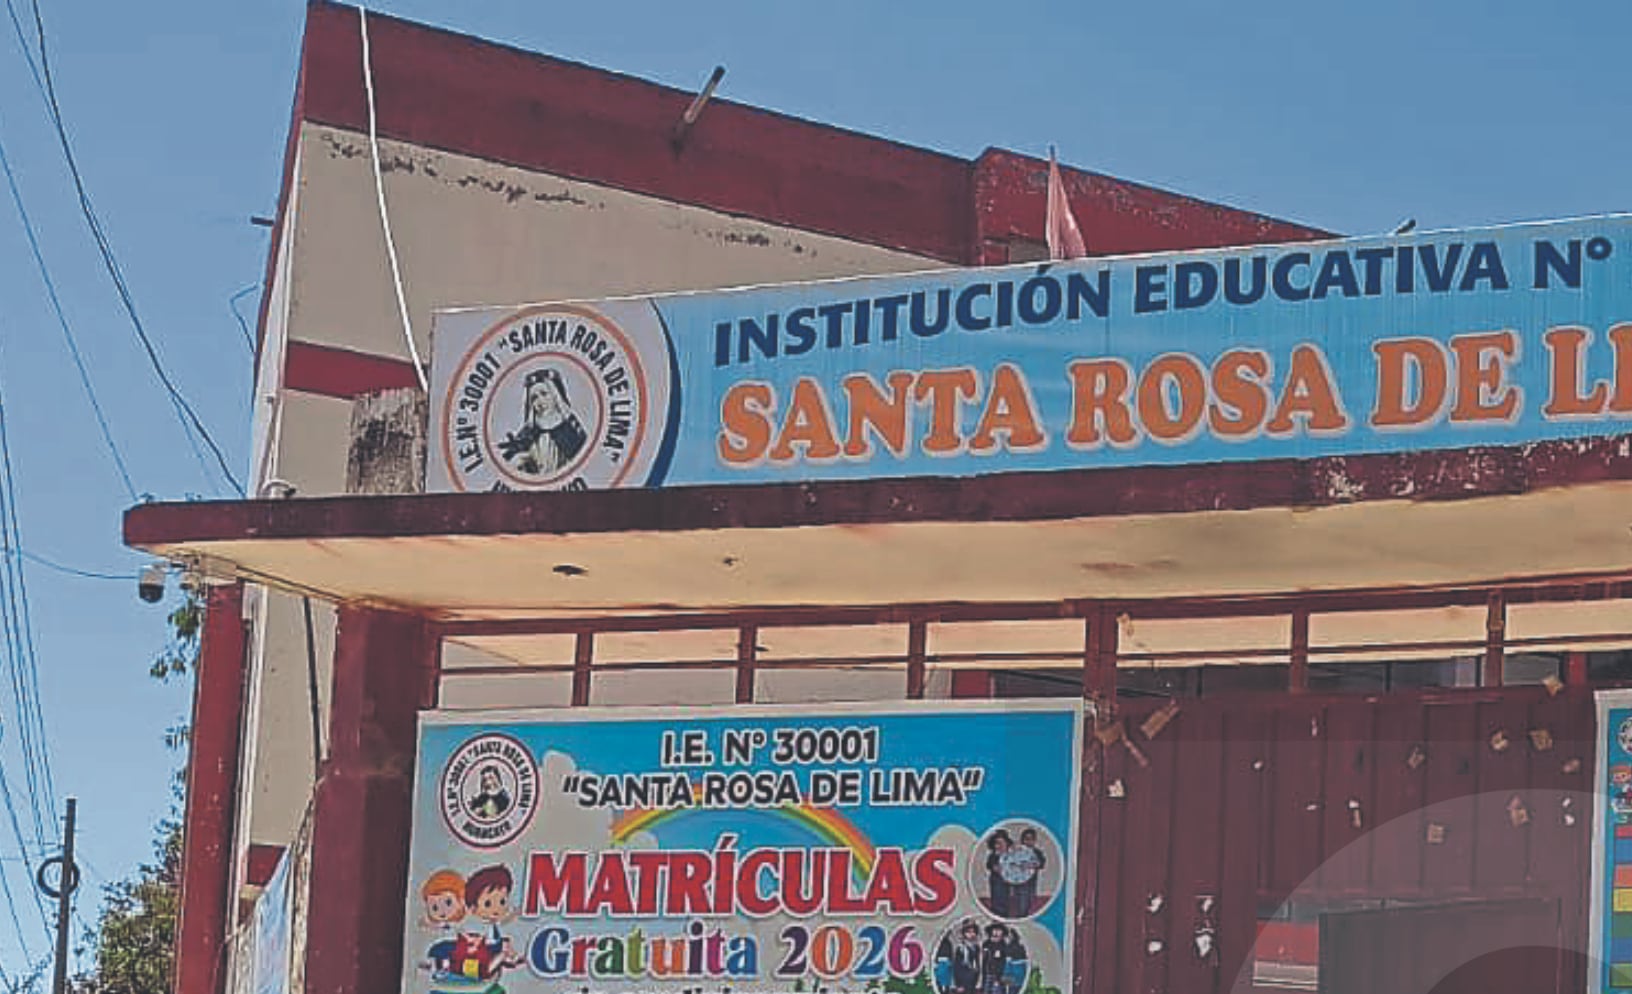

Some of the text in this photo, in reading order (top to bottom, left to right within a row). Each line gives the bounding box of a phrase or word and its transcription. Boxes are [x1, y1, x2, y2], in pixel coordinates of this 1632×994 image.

[714, 265, 1111, 367] INSTITUCIÓN
[1134, 239, 1508, 313] EDUCATIVA
[460, 351, 501, 413] 30001
[570, 324, 617, 371] ROSA
[603, 366, 630, 397] DE
[716, 362, 1045, 468] SANTA
[1067, 342, 1347, 448] ROSA
[1371, 329, 1520, 428] DE
[663, 731, 712, 765] I.E.
[773, 727, 878, 763] 30001
[704, 772, 800, 805] ROSA
[811, 771, 860, 804] DE
[524, 833, 957, 916] MATRÍCULAS
[528, 919, 924, 979] Gratuita 2026
